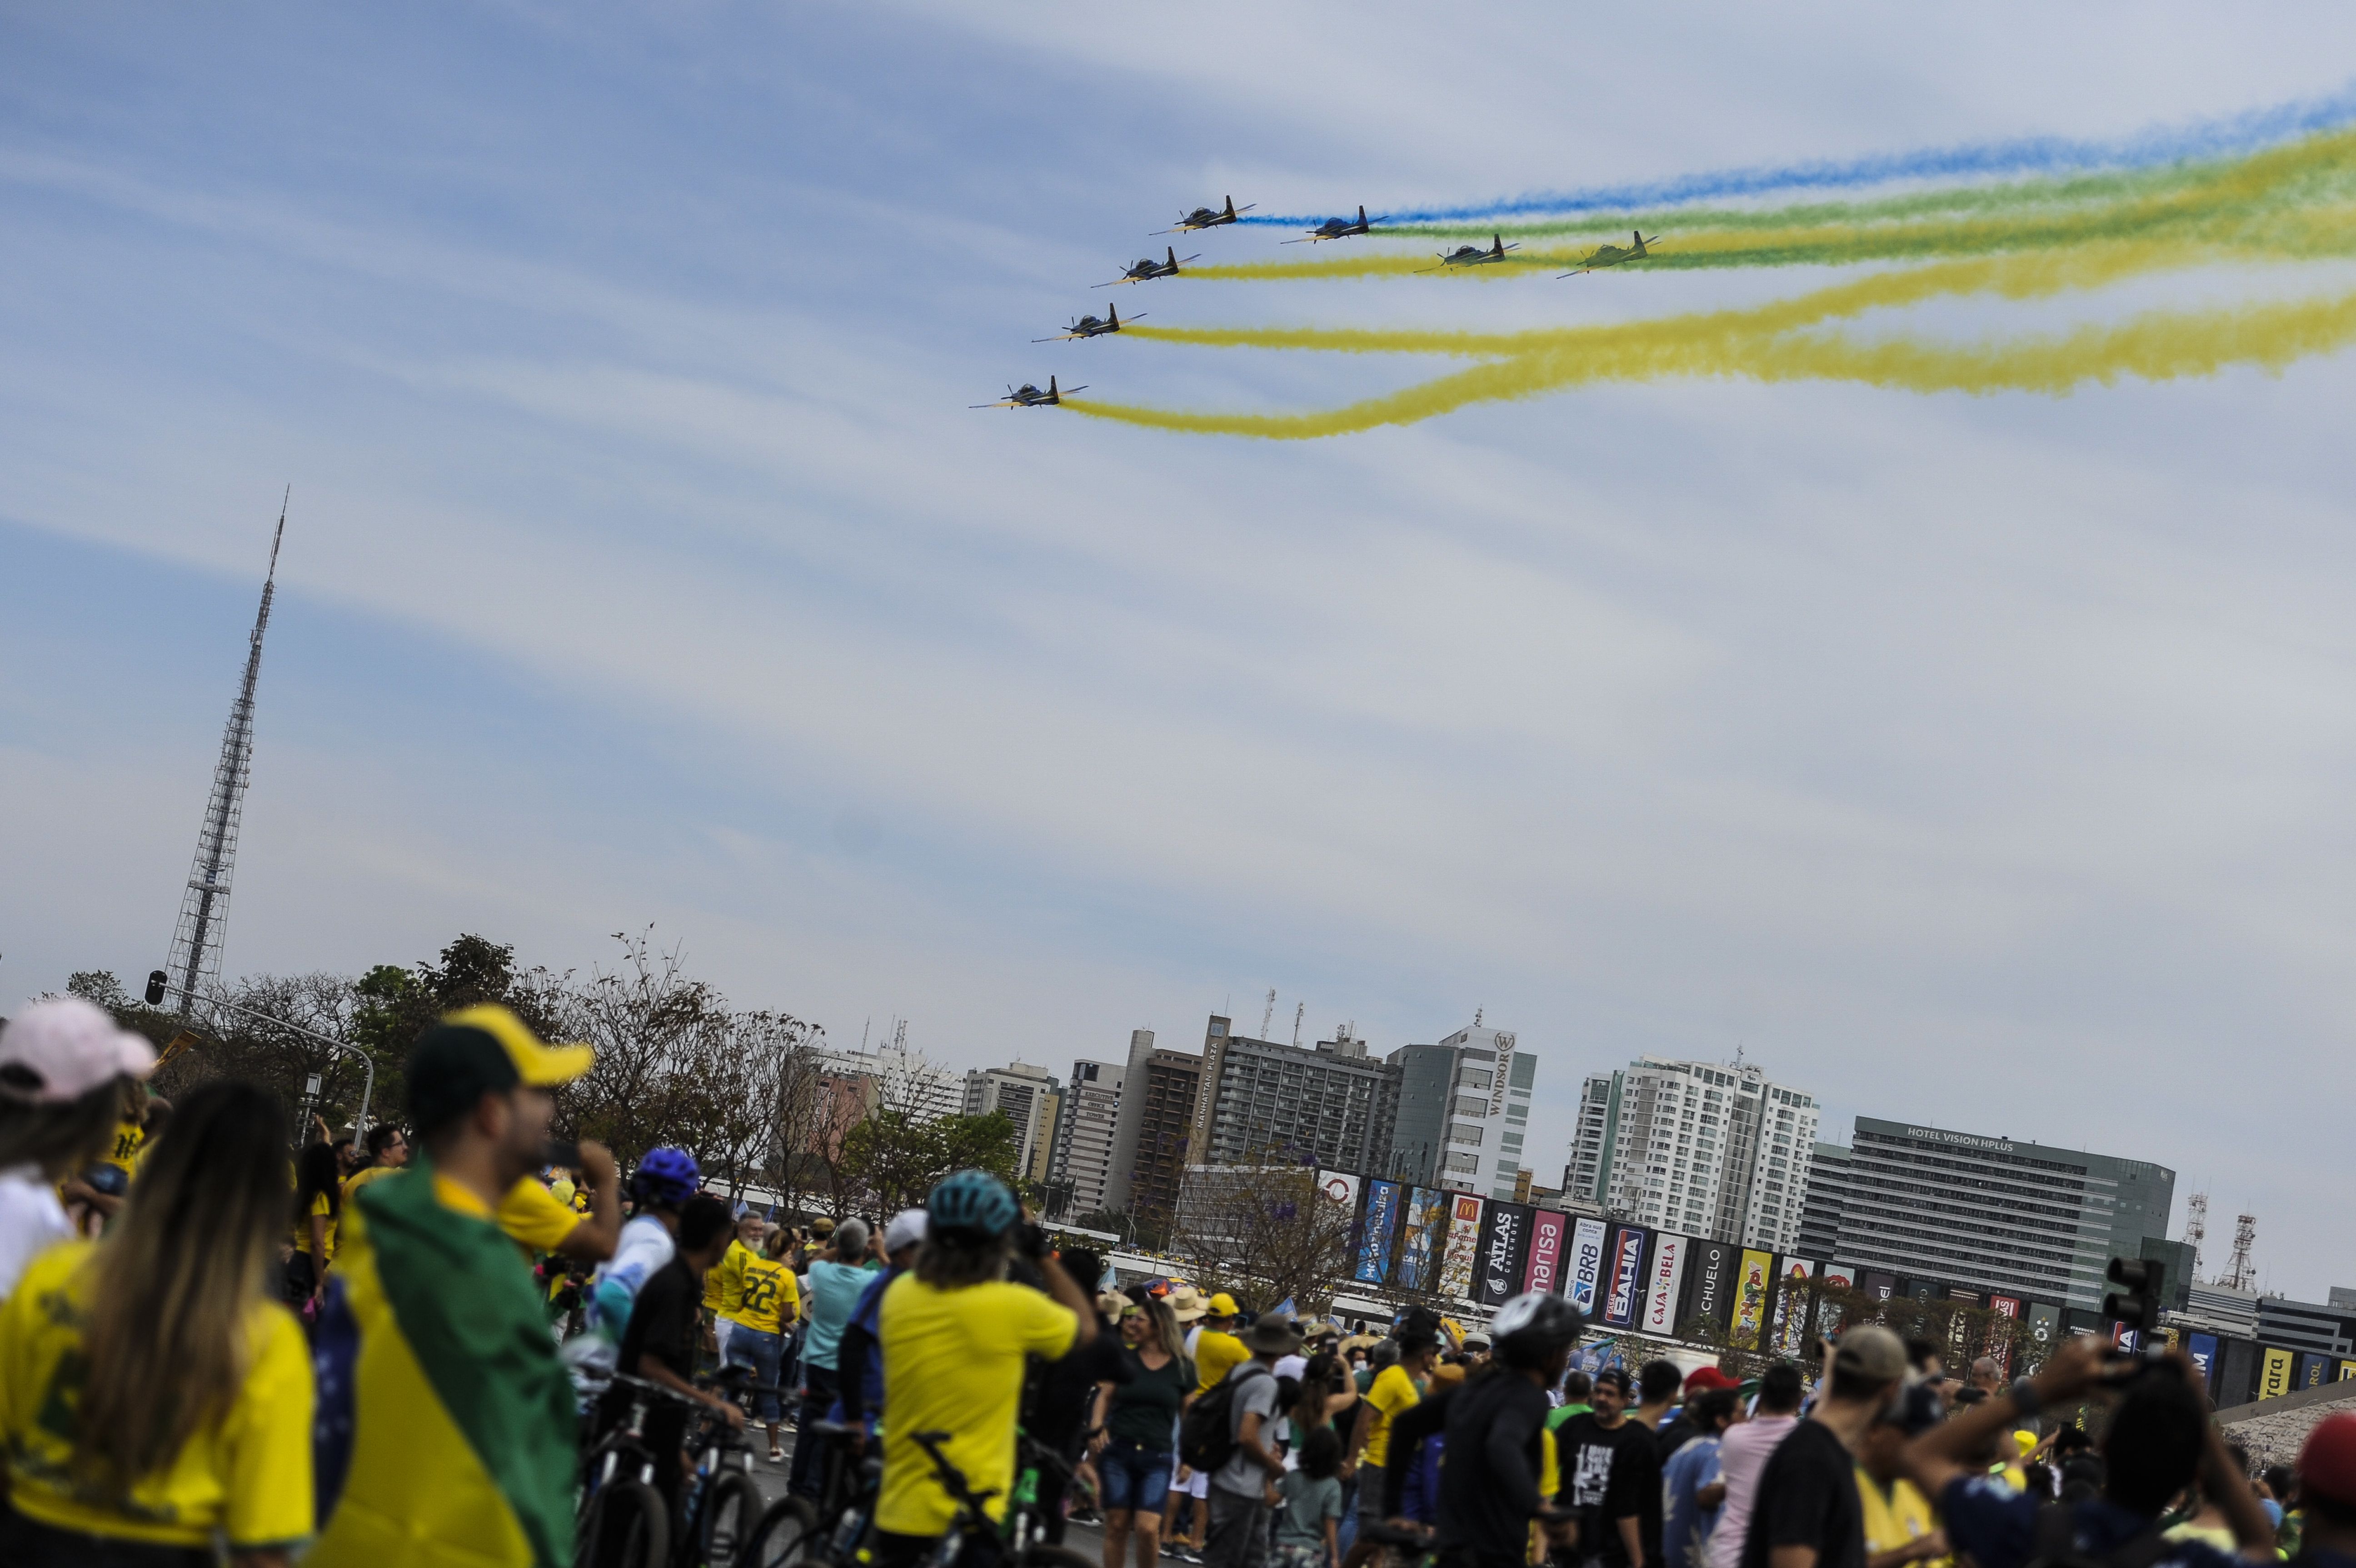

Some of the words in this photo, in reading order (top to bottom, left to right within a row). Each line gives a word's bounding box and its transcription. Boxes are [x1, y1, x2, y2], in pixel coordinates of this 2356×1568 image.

[1197, 1074, 1212, 1129] MANHATTAN
[1207, 1042, 1218, 1070] PLAZA
[1490, 1054, 1509, 1116] WINDSOR
[1908, 1127, 1940, 1140] HOTEL
[1943, 1133, 1978, 1146] VISION
[1981, 1139, 2013, 1152] HPLUS
[1490, 1213, 1512, 1272] ATLAS
[1577, 1243, 1598, 1283] BRB
[741, 1276, 776, 1315] 22
[1613, 1238, 1639, 1316] BAHIA
[1652, 1292, 1667, 1325] CASA
[1660, 1244, 1676, 1278] BELA
[1700, 1249, 1720, 1315] CHUELO
[1739, 1261, 1762, 1317] HAPPY
[1608, 1293, 1617, 1314] CASAS
[2070, 1326, 2096, 1334] STARBUCKS
[2266, 1358, 2284, 1397] rara
[2309, 1362, 2321, 1385] ROL
